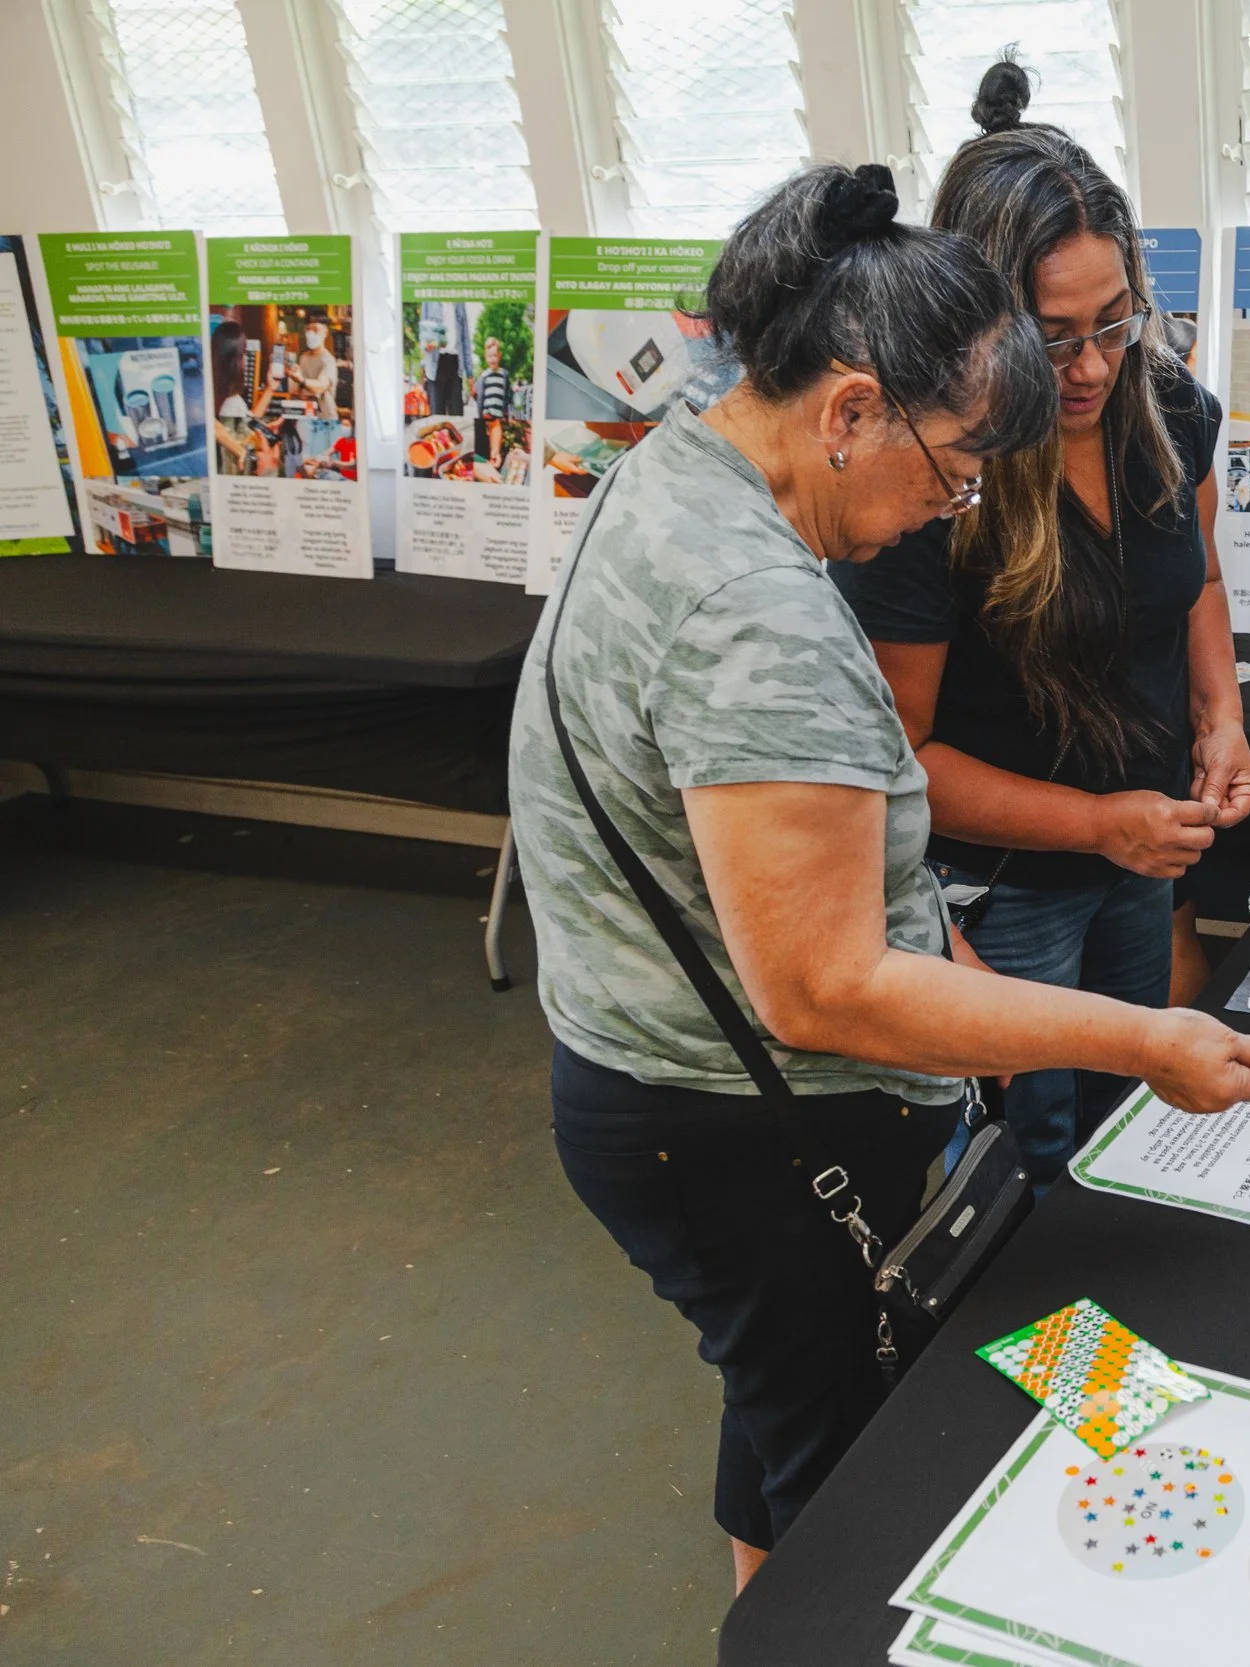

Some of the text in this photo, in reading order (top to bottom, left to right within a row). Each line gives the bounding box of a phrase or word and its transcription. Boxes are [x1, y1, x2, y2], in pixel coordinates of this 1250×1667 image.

[597, 246, 600, 255] E
[654, 247, 668, 256] KA
[598, 262, 620, 273] Drop
[623, 262, 635, 272] off
[637, 265, 657, 274] your
[613, 282, 633, 290] ANG
[1234, 540, 1250, 548] hale
[1141, 1501, 1157, 1519] NO
